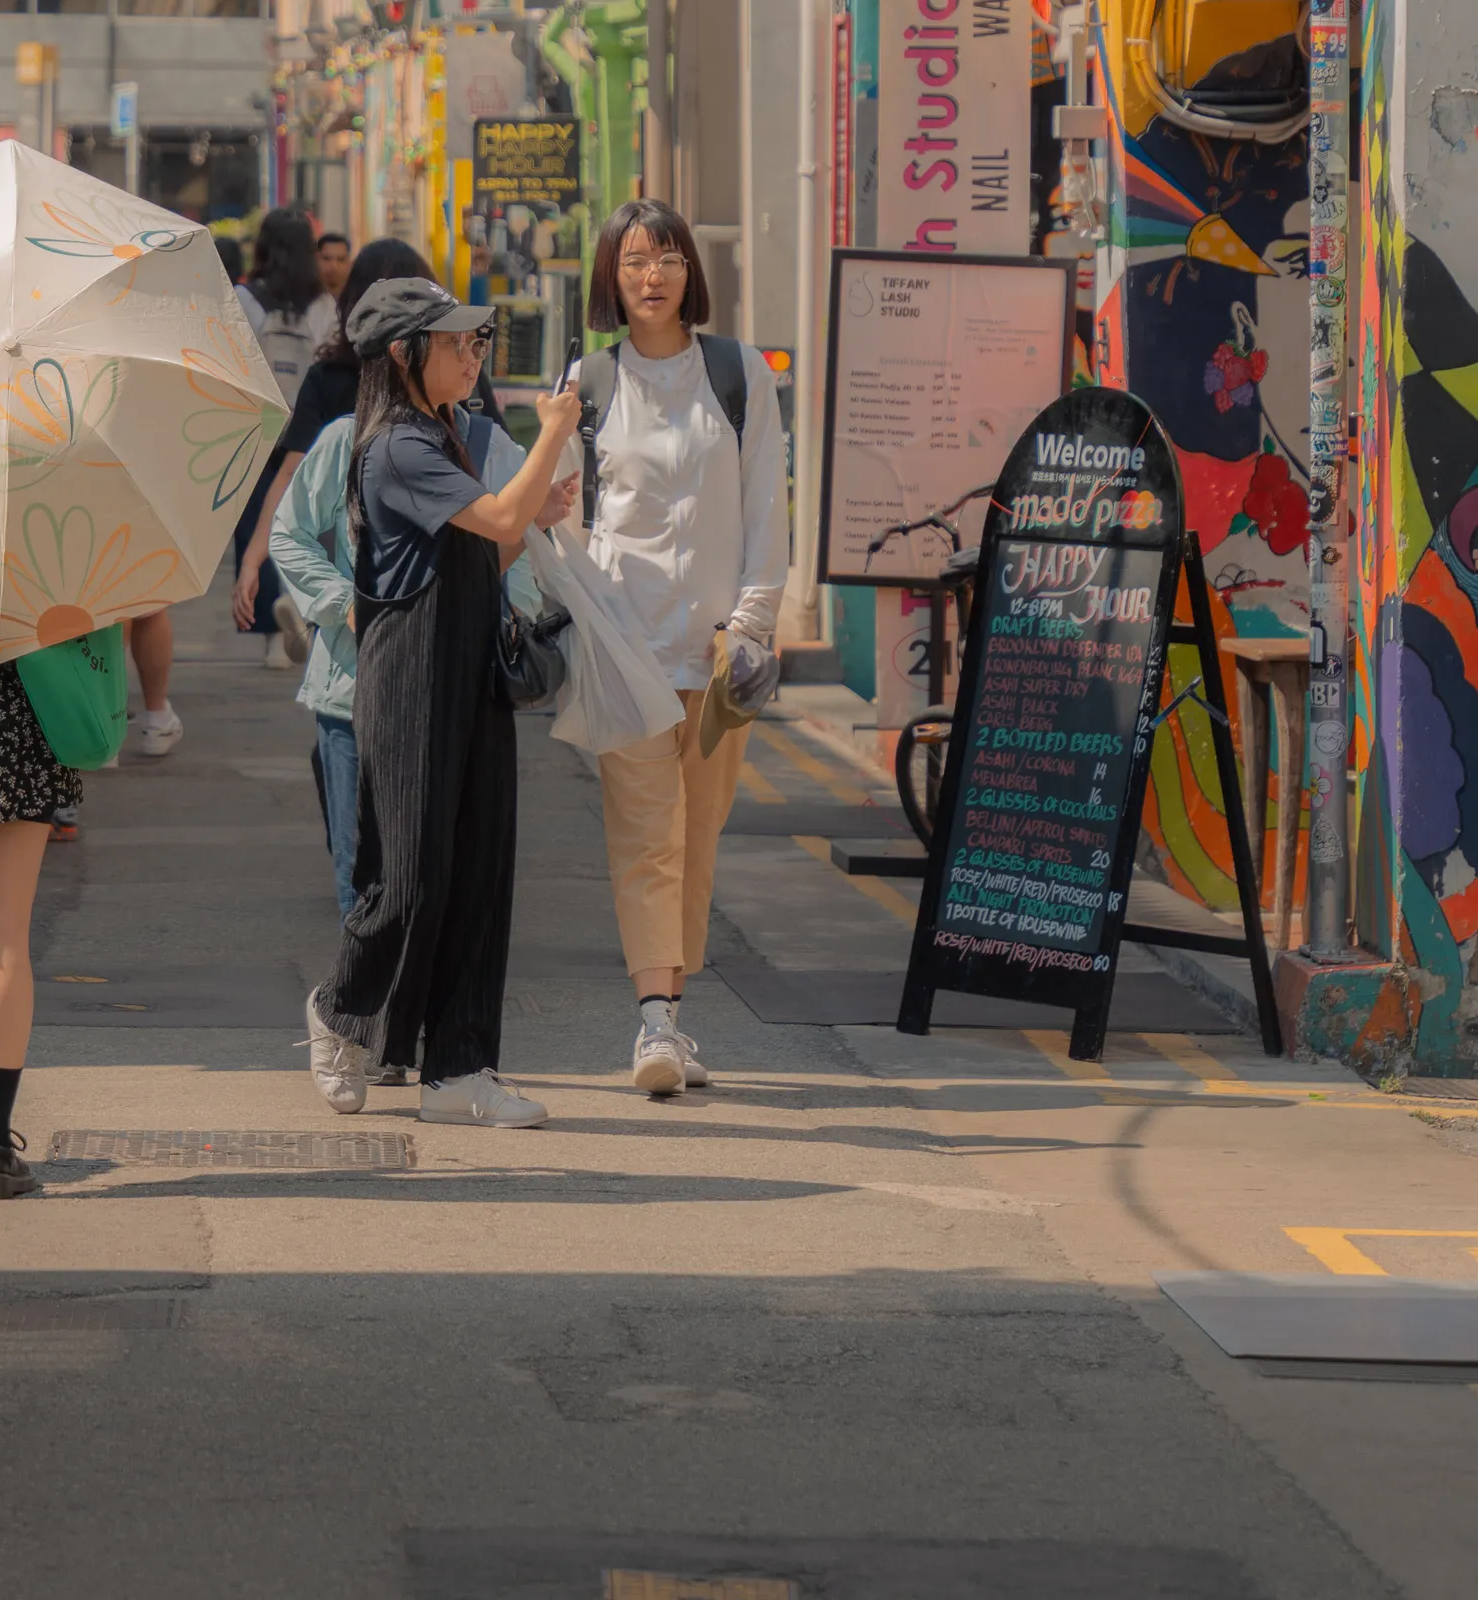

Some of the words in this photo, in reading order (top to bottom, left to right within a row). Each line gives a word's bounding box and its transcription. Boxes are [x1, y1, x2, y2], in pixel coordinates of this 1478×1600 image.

[477, 122, 574, 141] HAPPY
[477, 139, 574, 157] HAPPY
[487, 156, 566, 175] HOUR
[970, 147, 1010, 212] NAIL
[881, 276, 931, 291] TIFFANY
[880, 291, 912, 304] LASH
[880, 305, 921, 319] STUDIO
[1036, 432, 1146, 471] Welcome
[1010, 473, 1101, 531] madd
[1092, 498, 1165, 539] pizza
[1001, 544, 1108, 595] HAPPY
[1010, 597, 1063, 618] 12-8PM
[1069, 585, 1152, 625] HOUR
[991, 616, 1035, 635] DRAFT
[1038, 617, 1084, 639] BEERS
[988, 637, 1059, 655] BROOKLYN
[1062, 639, 1122, 660] DEFENDER
[1126, 645, 1143, 664] IPA
[1076, 663, 1115, 681] BLANC
[982, 676, 1019, 694] ASAHI
[1020, 679, 1062, 696] SUPER
[1063, 681, 1090, 698] DRY
[979, 694, 1016, 710] ASAHI
[1021, 699, 1059, 715] BLACK
[1136, 715, 1151, 734] 12
[975, 727, 989, 748] 2
[992, 727, 1067, 754] BOTTLED
[1069, 731, 1124, 757] BEERS
[1019, 716, 1054, 732] BERG
[1133, 738, 1147, 755] 10
[1093, 762, 1108, 781] 14
[964, 787, 980, 806] 2
[979, 788, 1041, 813] GLASSES
[1043, 795, 1059, 813] OF
[1059, 797, 1118, 822] COCKTAILS
[1088, 786, 1102, 805] 16
[953, 848, 967, 866] 2
[968, 848, 1026, 872] GLASSES
[1026, 857, 1045, 873] OF
[966, 831, 1026, 855] CAMPARI
[1090, 849, 1111, 869] 20
[945, 882, 972, 904] ALL
[975, 887, 1013, 911] NIGHT
[1107, 890, 1123, 912] 18
[998, 911, 1017, 930] OF
[1017, 914, 1088, 941] HOUSEWINE
